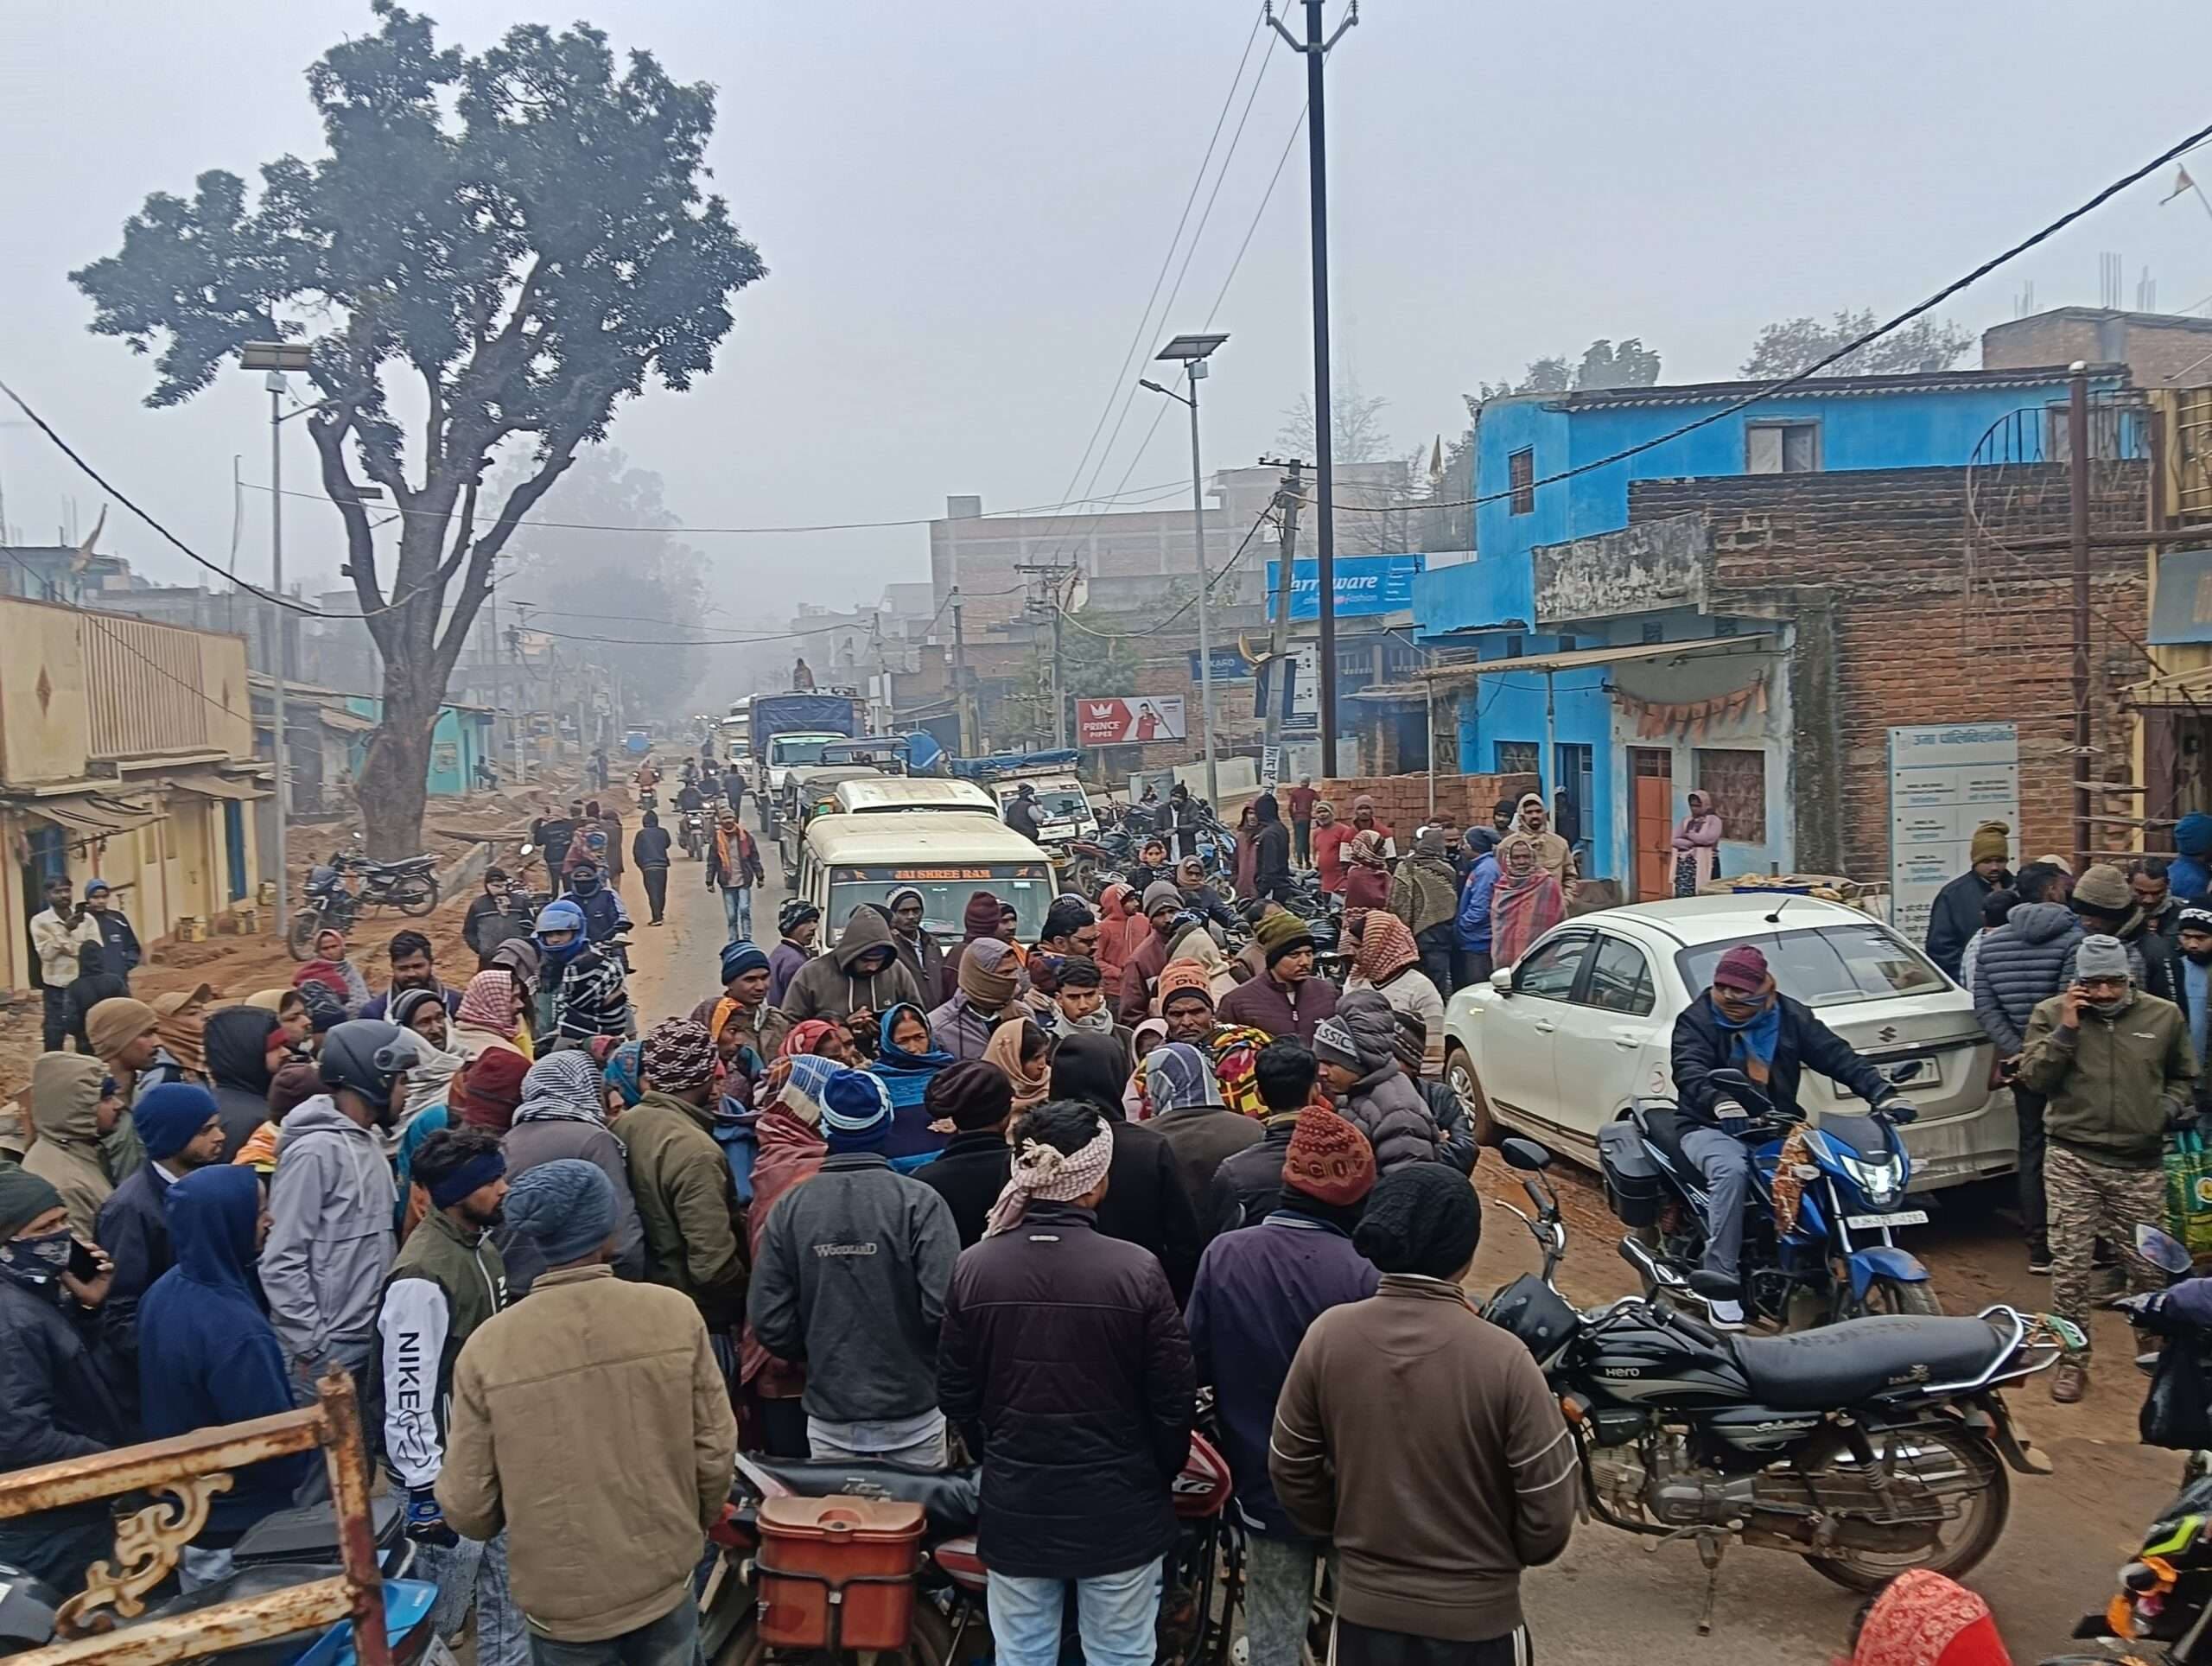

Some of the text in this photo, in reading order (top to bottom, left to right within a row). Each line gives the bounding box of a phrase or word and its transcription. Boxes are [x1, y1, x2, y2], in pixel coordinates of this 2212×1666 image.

[1083, 721, 1121, 731] PRINCE
[917, 869, 961, 879] SHREE
[398, 1332, 420, 1408] NIKE
